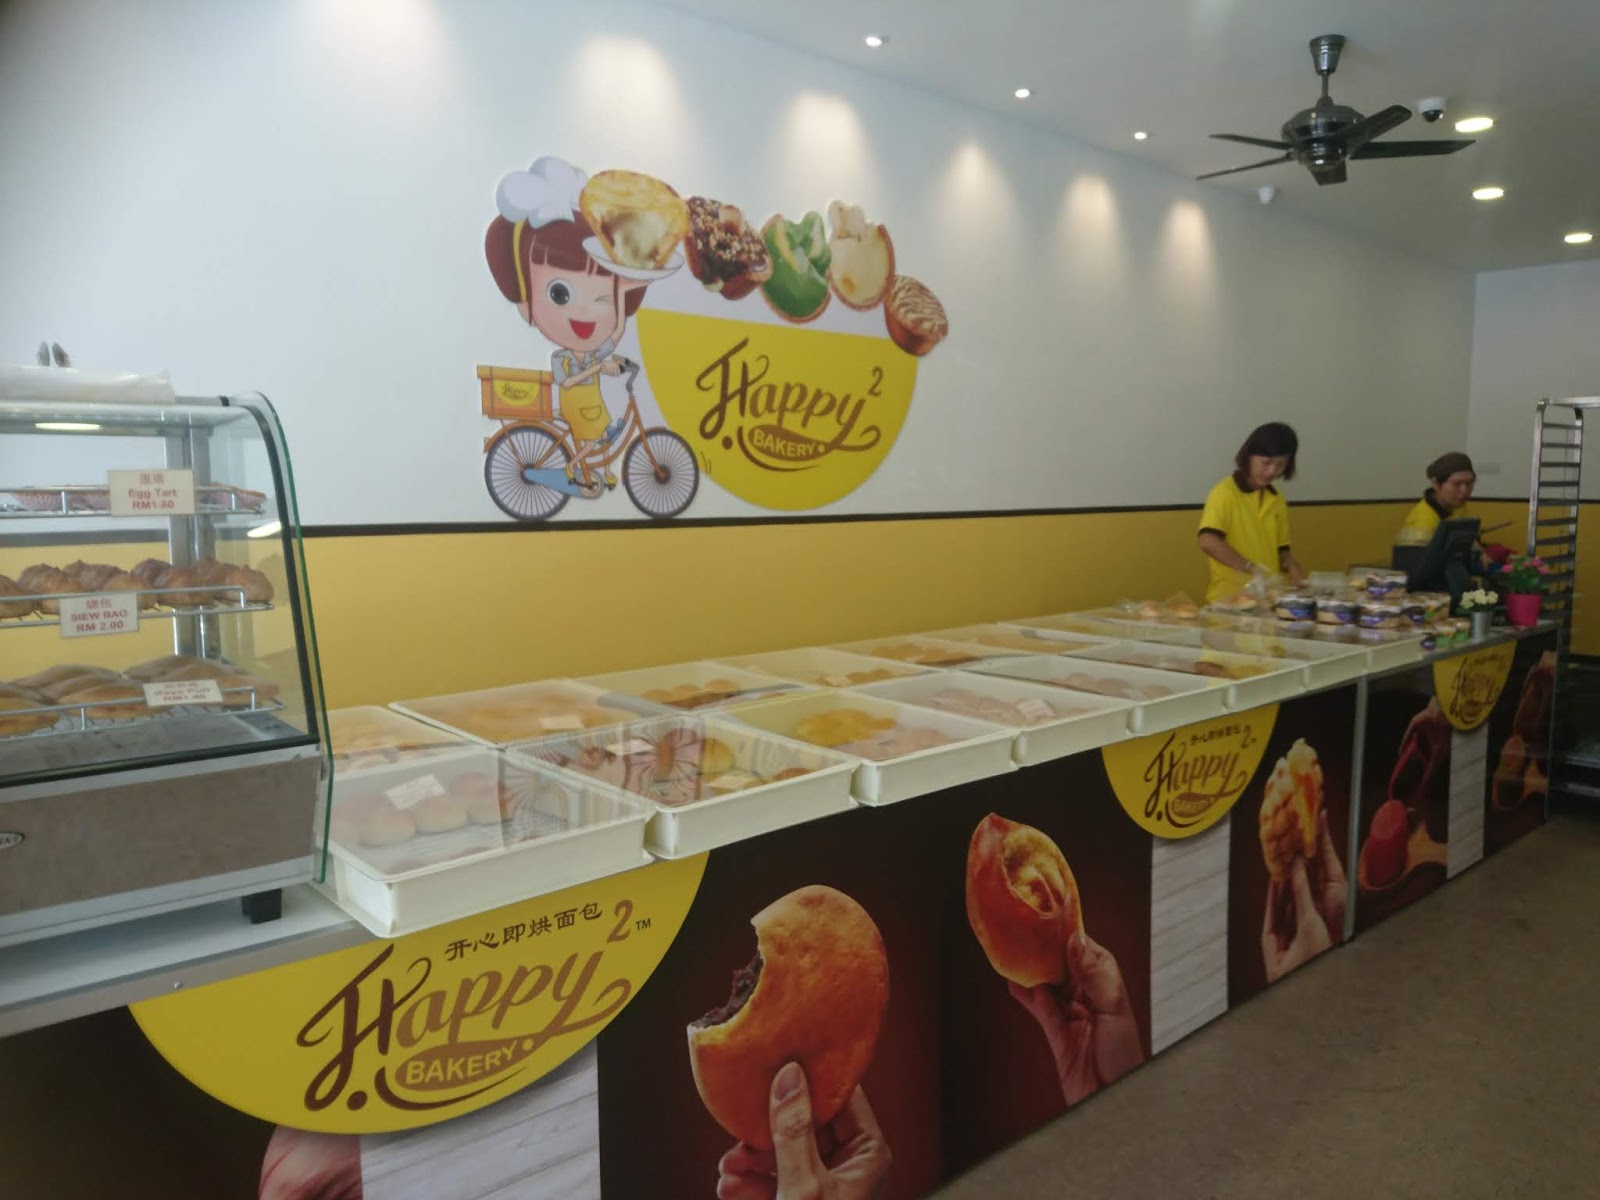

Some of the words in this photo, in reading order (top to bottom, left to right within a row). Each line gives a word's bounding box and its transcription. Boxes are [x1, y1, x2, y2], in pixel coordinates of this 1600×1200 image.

[696, 337, 882, 453] Happy
[753, 429, 816, 457] BAKERY
[128, 488, 151, 499] Egg
[155, 488, 177, 497] Tart
[71, 612, 100, 622] SIEW
[103, 609, 128, 619] BAO
[76, 623, 96, 632] RM
[99, 620, 124, 631] 2.00
[1144, 732, 1248, 818] Happy
[444, 902, 604, 961] 开心即烘面包
[296, 944, 632, 1111] Happy
[606, 899, 634, 944] 2
[406, 1047, 516, 1086] BAKERY
